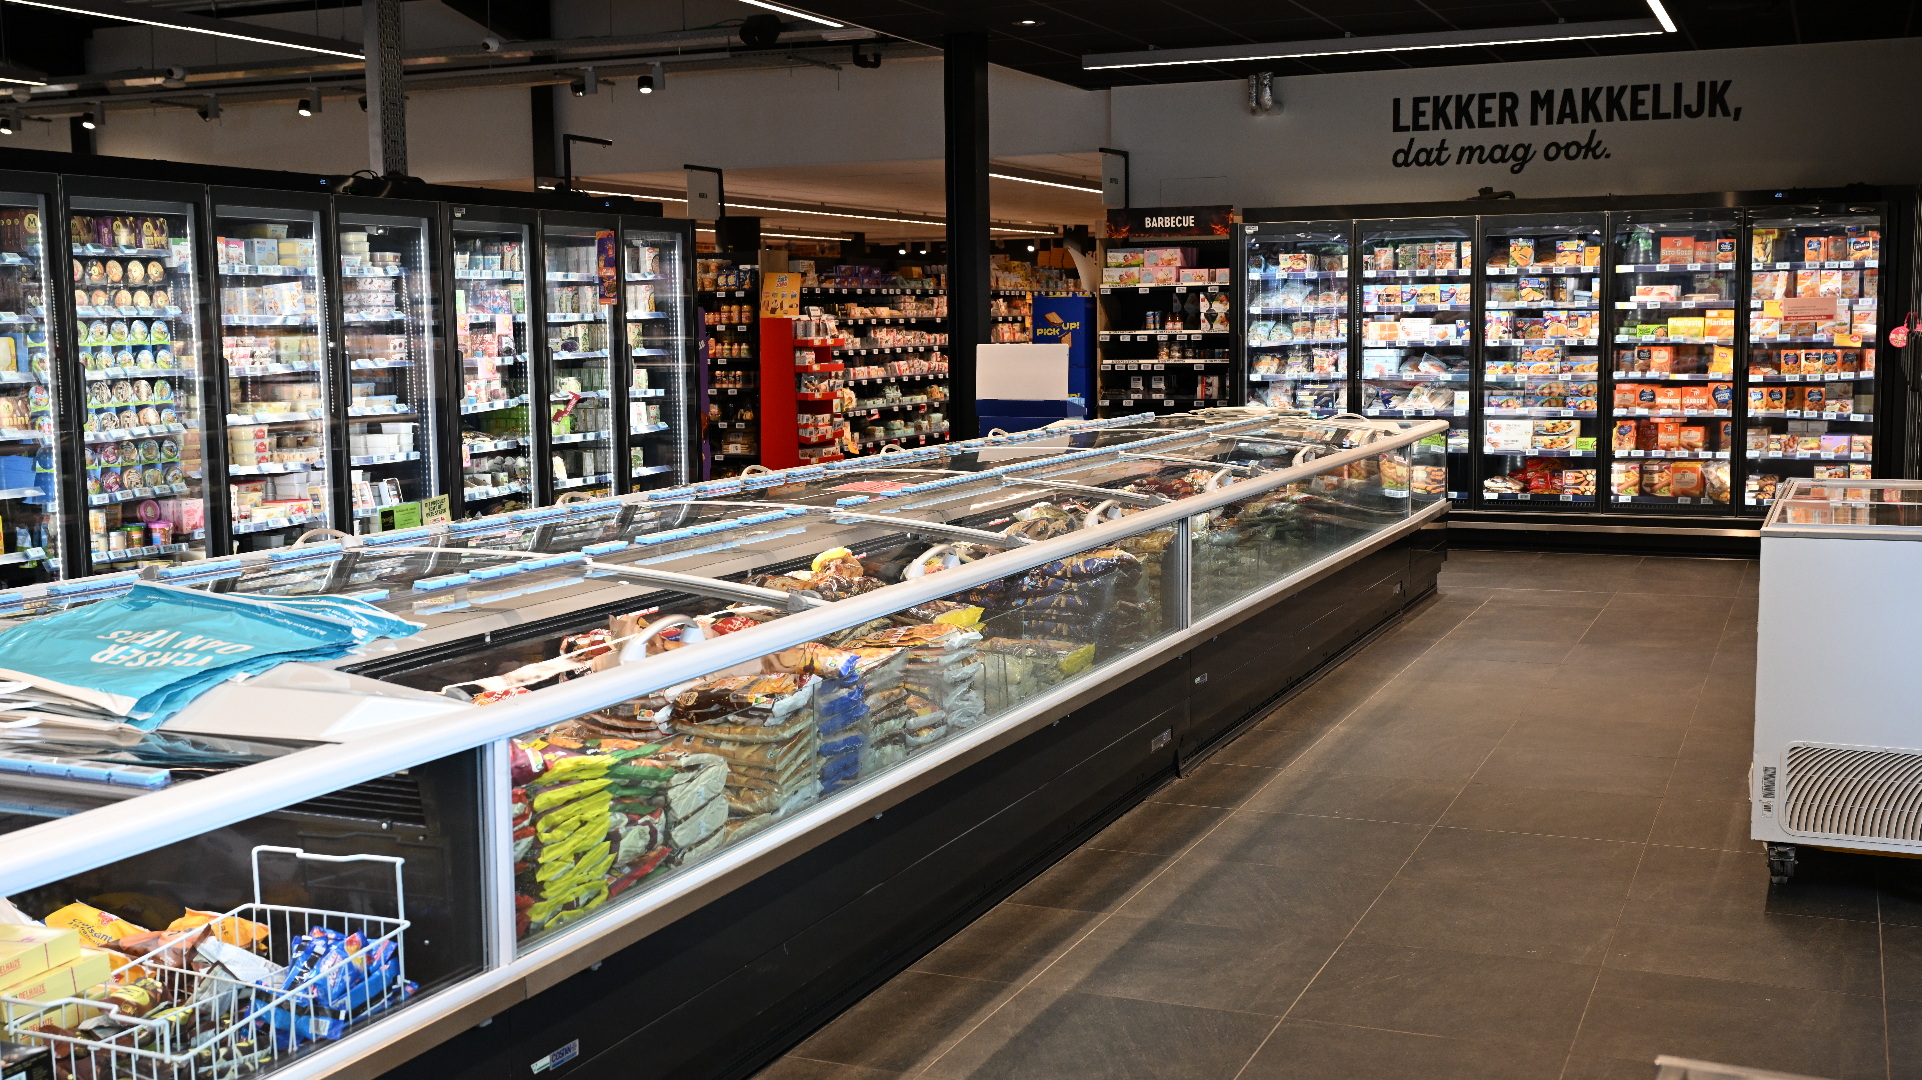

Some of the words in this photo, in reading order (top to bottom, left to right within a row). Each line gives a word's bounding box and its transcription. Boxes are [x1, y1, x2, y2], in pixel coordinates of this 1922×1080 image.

[1392, 91, 1519, 132] LEKKER
[1530, 80, 1743, 126] MAKKELIJK,
[1392, 138, 1451, 168] dat
[1455, 140, 1537, 174] mag
[1543, 129, 1612, 162] ook.
[1145, 216, 1195, 229] BARBECUE
[1036, 328, 1060, 336] PICK
[1061, 321, 1080, 331] UP!
[1670, 319, 1702, 327] PlanTasty
[97, 629, 182, 650] VERS
[178, 634, 255, 655] DAN
[90, 644, 214, 667] VERSER
[0, 957, 21, 974] ELHAIZE
[18, 983, 46, 1000] DELHAIZE
